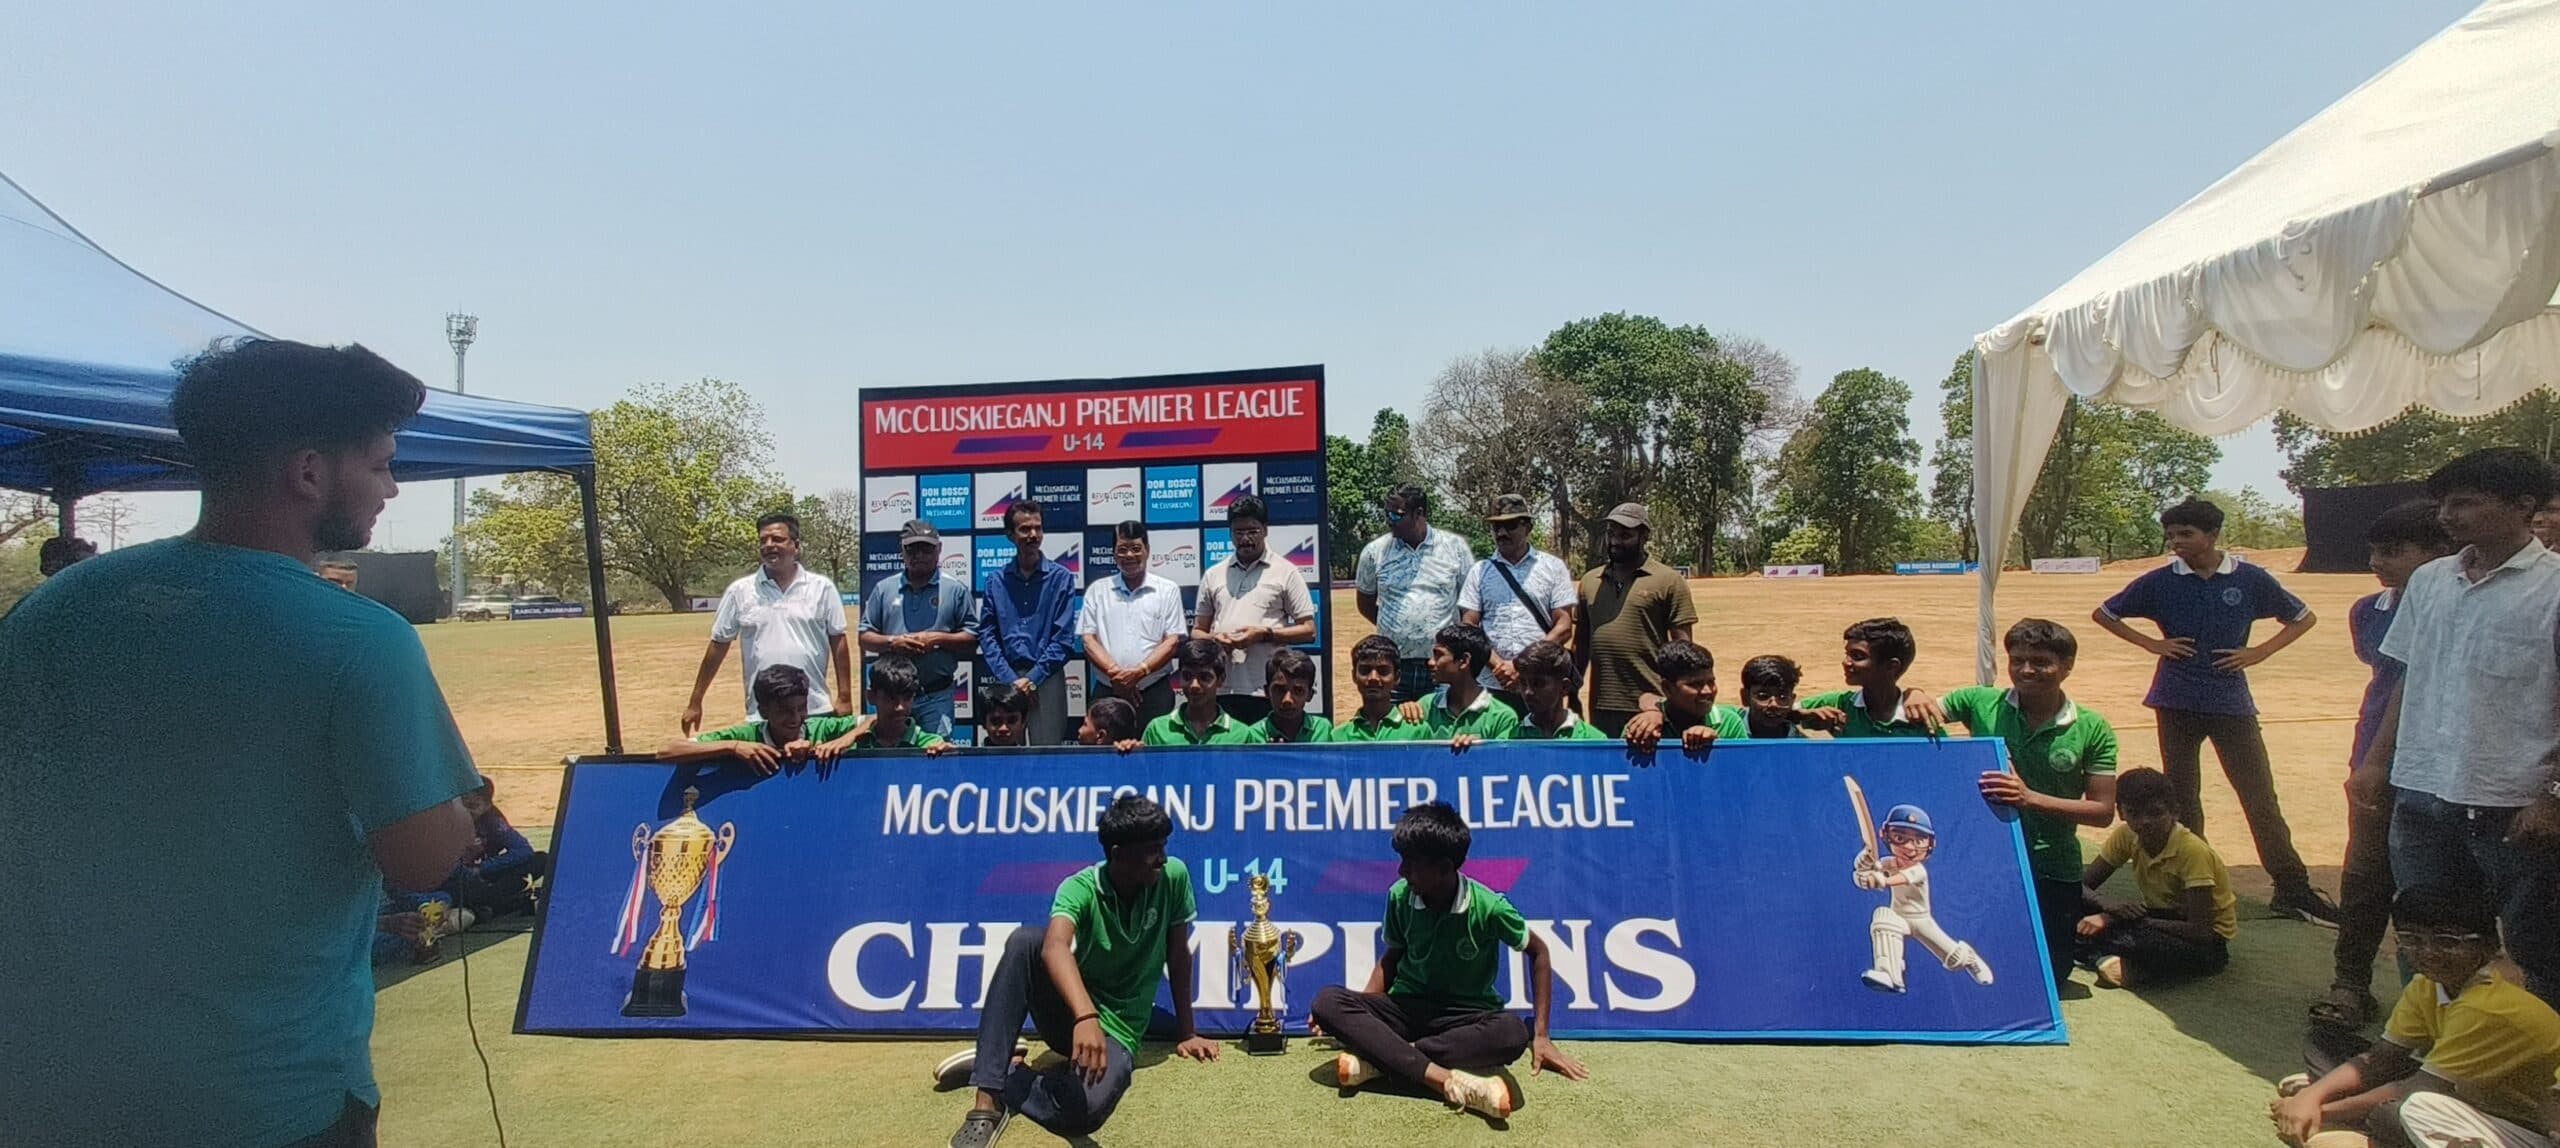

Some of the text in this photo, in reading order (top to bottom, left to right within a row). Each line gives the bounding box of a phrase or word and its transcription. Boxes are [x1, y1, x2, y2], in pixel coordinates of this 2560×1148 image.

[875, 387, 1304, 434] McCLUSKIEGANJ PREMIER LEAGUE
[1063, 433, 1105, 452] U-14
[1147, 479, 1196, 489] DON BOSCO
[921, 487, 970, 497] DON BOSCO
[1151, 490, 1193, 499] ACADEMY
[925, 498, 966, 507] ACADEMY
[976, 549, 995, 558] DON
[1457, 774, 1634, 828] LEAGUE
